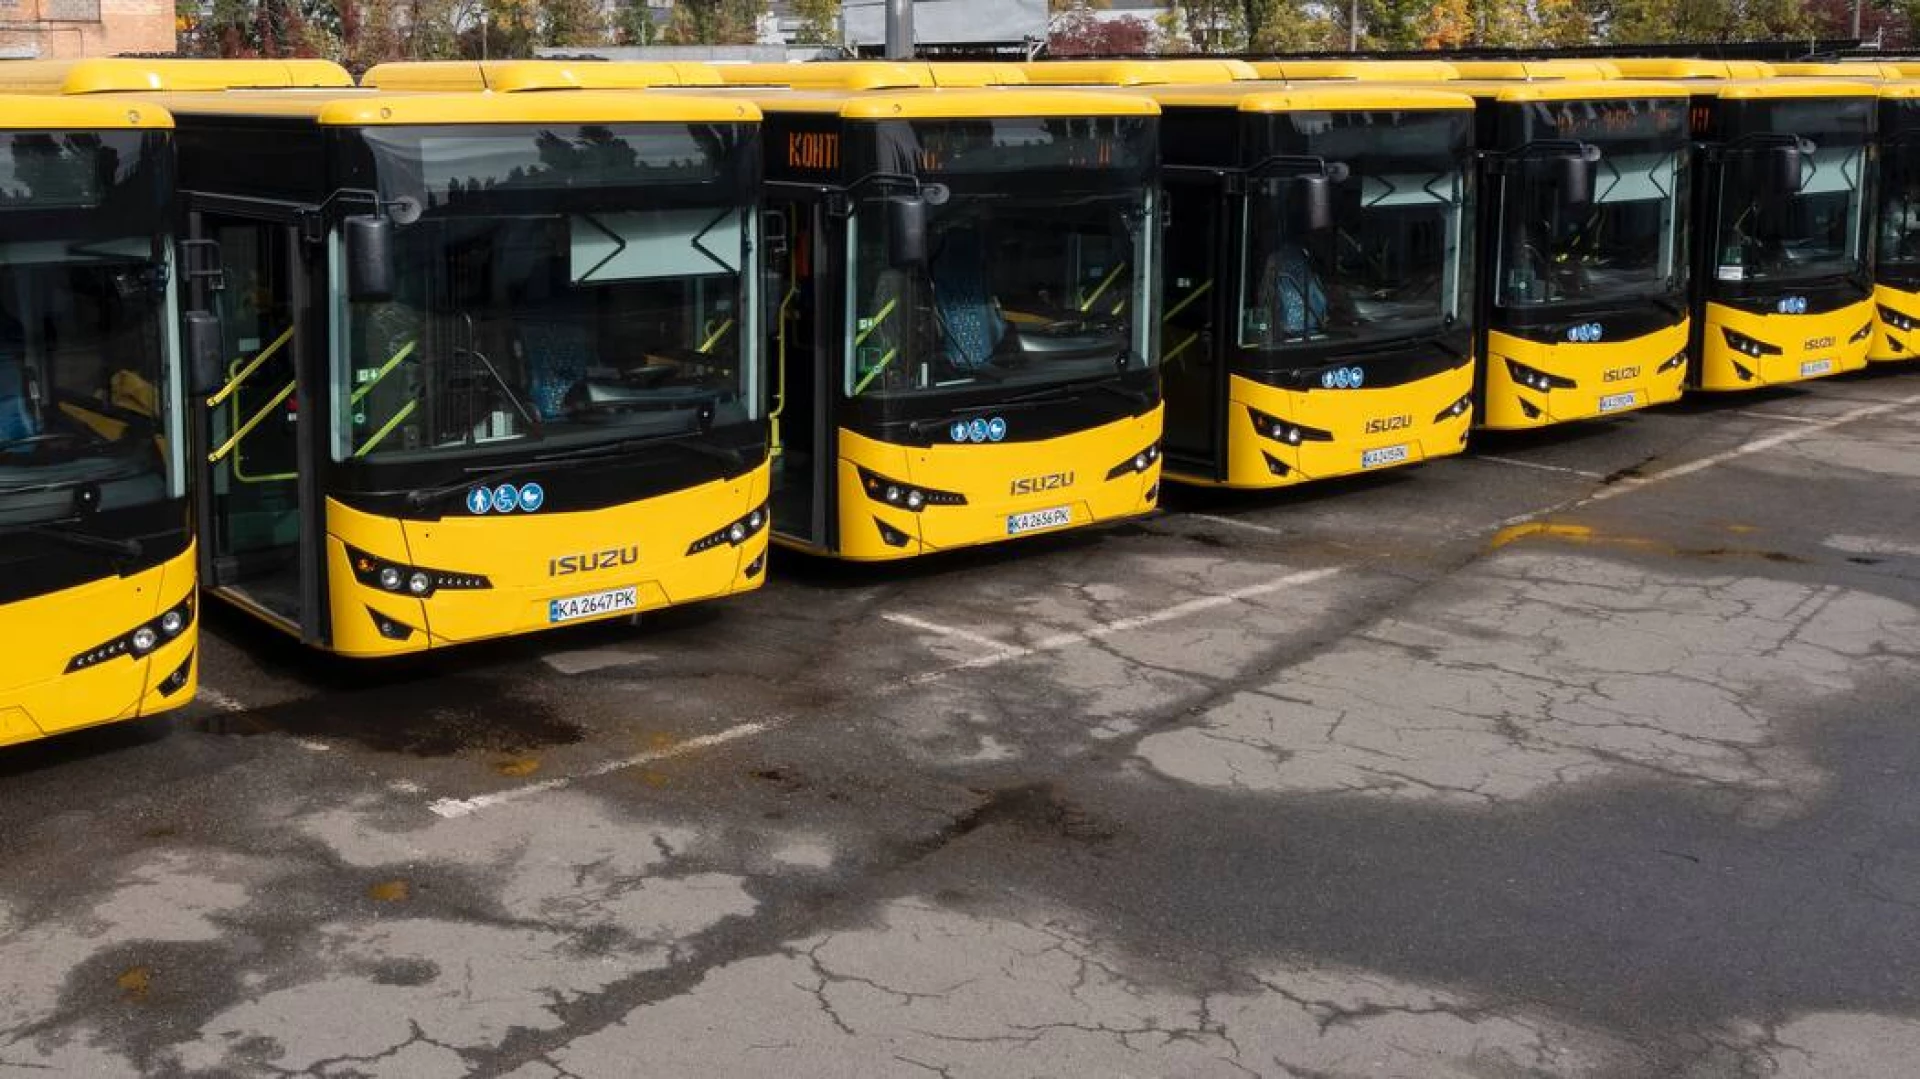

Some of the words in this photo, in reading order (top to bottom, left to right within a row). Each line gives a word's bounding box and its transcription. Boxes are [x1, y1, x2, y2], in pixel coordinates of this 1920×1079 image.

[1603, 366, 1640, 382] ISUZU
[1365, 414, 1412, 434] ISUZU
[1010, 471, 1074, 496] ISUZU
[549, 546, 638, 577] ISUZU
[559, 599, 579, 617] KA
[581, 594, 613, 613] 2647
[615, 590, 634, 607] PK
